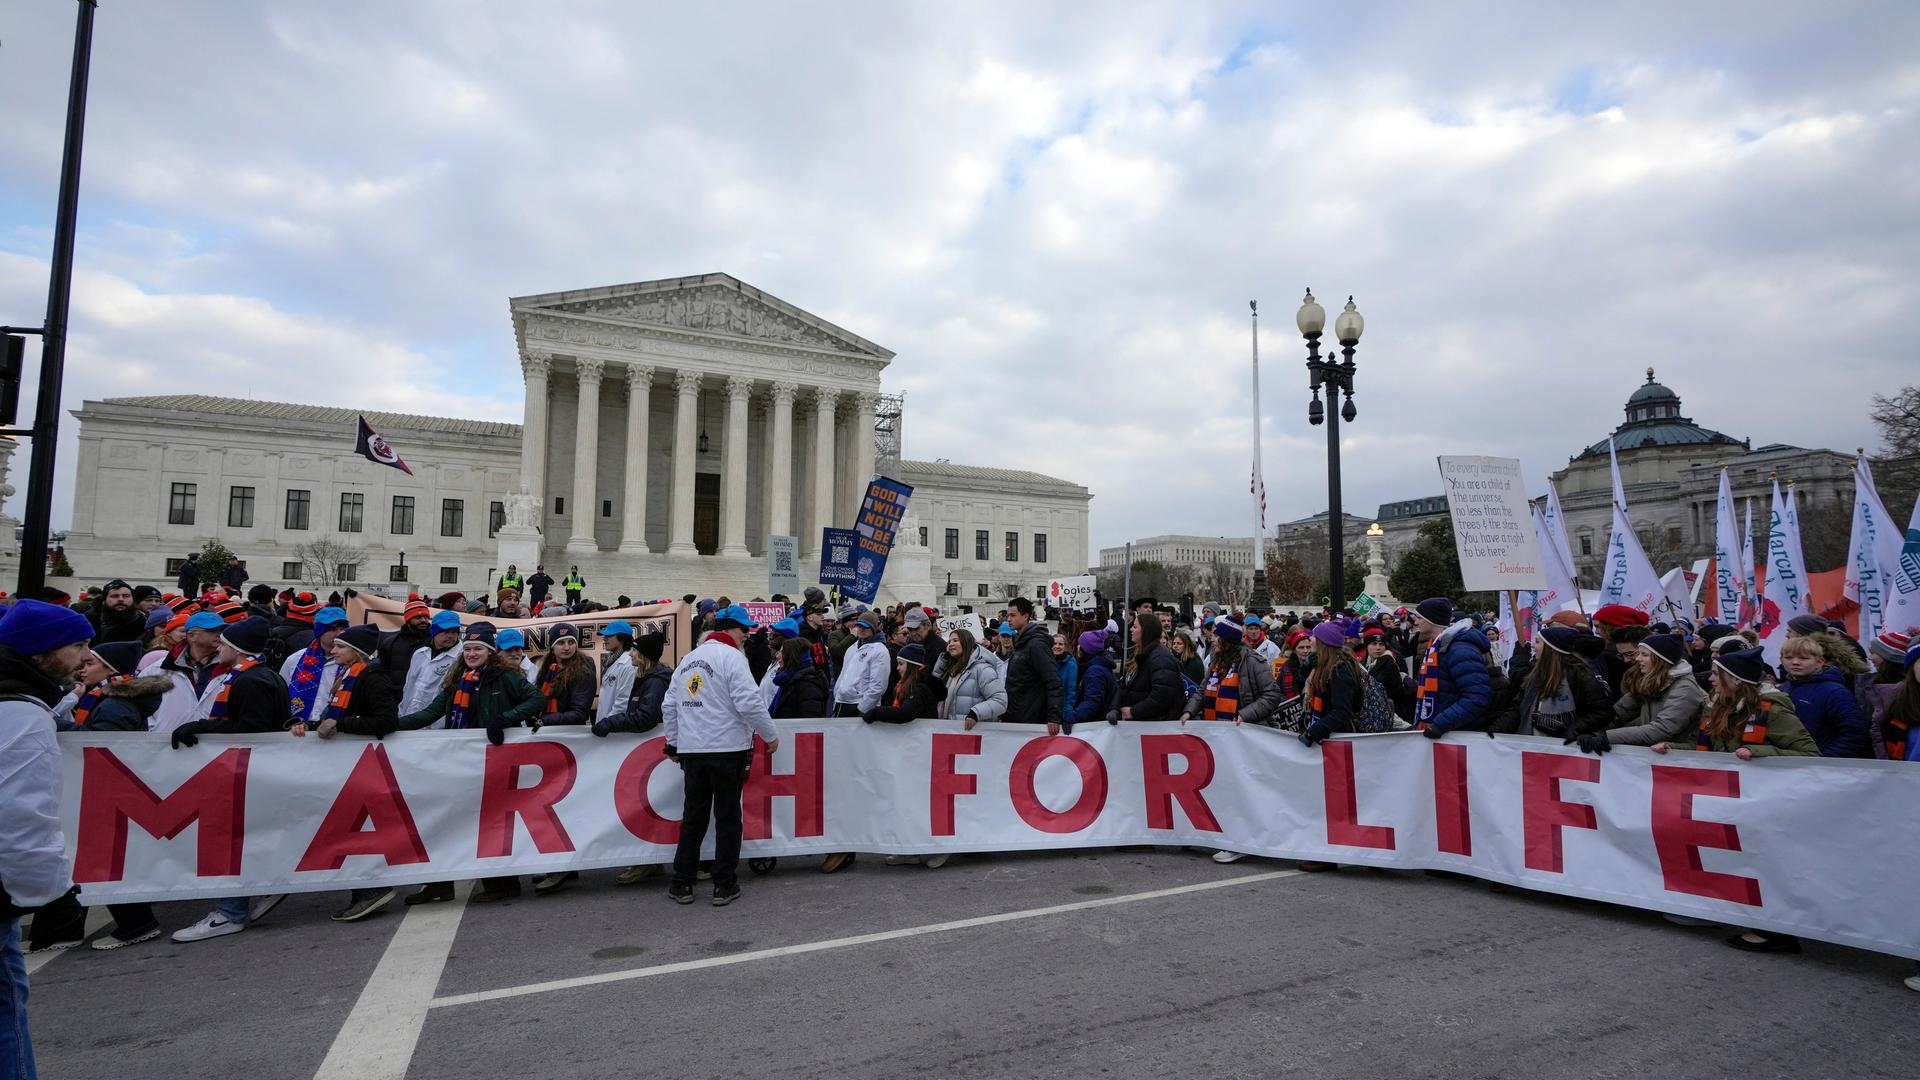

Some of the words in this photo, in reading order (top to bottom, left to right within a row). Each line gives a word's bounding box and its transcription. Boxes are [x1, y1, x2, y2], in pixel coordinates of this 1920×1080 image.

[1445, 461, 1455, 473] To
[1457, 464, 1478, 477] every
[1467, 480, 1480, 490] are
[1481, 481, 1487, 489] a
[1488, 479, 1503, 490] child
[871, 485, 897, 501] GOD
[1453, 491, 1467, 502] the
[873, 500, 901, 519] WILL
[1456, 508, 1465, 516] no
[1466, 505, 1482, 516] less
[1484, 504, 1500, 516] than
[865, 512, 893, 529] NOT
[1458, 518, 1481, 530] trees
[1488, 518, 1501, 530] the
[873, 530, 891, 544] BE
[1460, 531, 1478, 545] You
[1480, 532, 1500, 543] have
[1501, 534, 1507, 543] a
[1507, 533, 1525, 547] right
[859, 537, 889, 556] OCKED
[1464, 546, 1473, 557] to
[1474, 545, 1486, 557] be
[1059, 596, 1080, 607] Life
[1283, 703, 1302, 716] THE
[72, 732, 824, 884] MARCH
[931, 734, 1223, 837] FOR
[1322, 741, 1762, 907] LIFE
